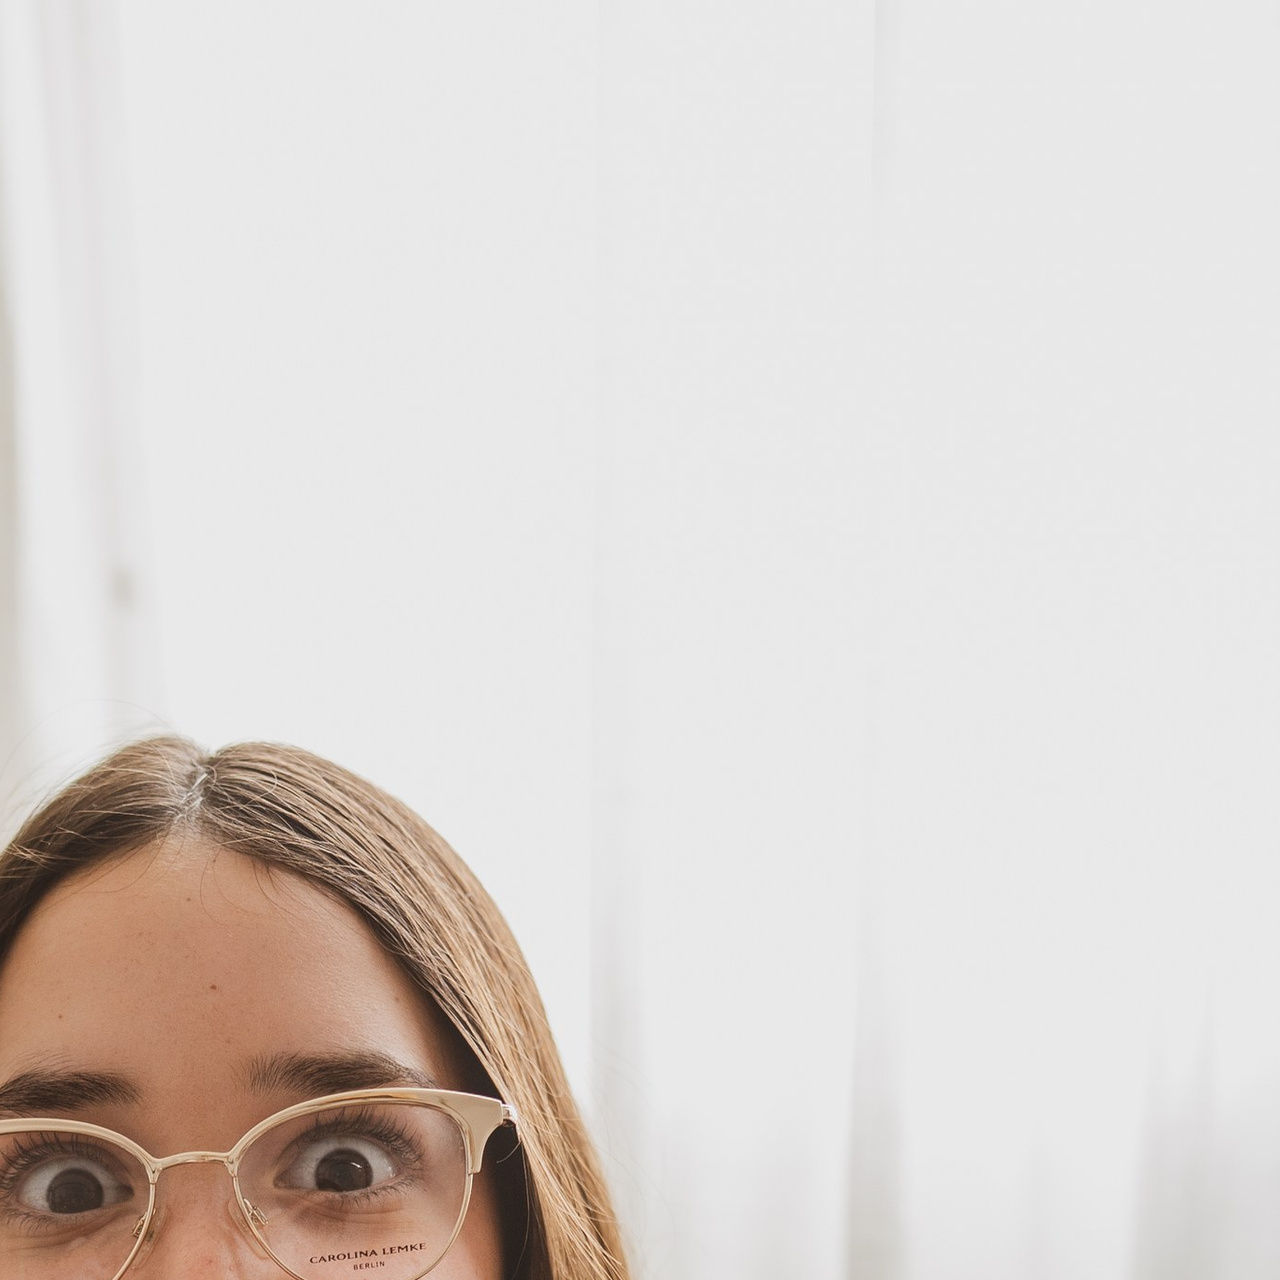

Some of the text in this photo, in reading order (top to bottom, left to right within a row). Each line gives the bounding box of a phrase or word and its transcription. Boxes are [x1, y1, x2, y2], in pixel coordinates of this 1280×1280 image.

[308, 1242, 427, 1264] CAROLINA LEMKE
[353, 1261, 386, 1271] BERLIN
